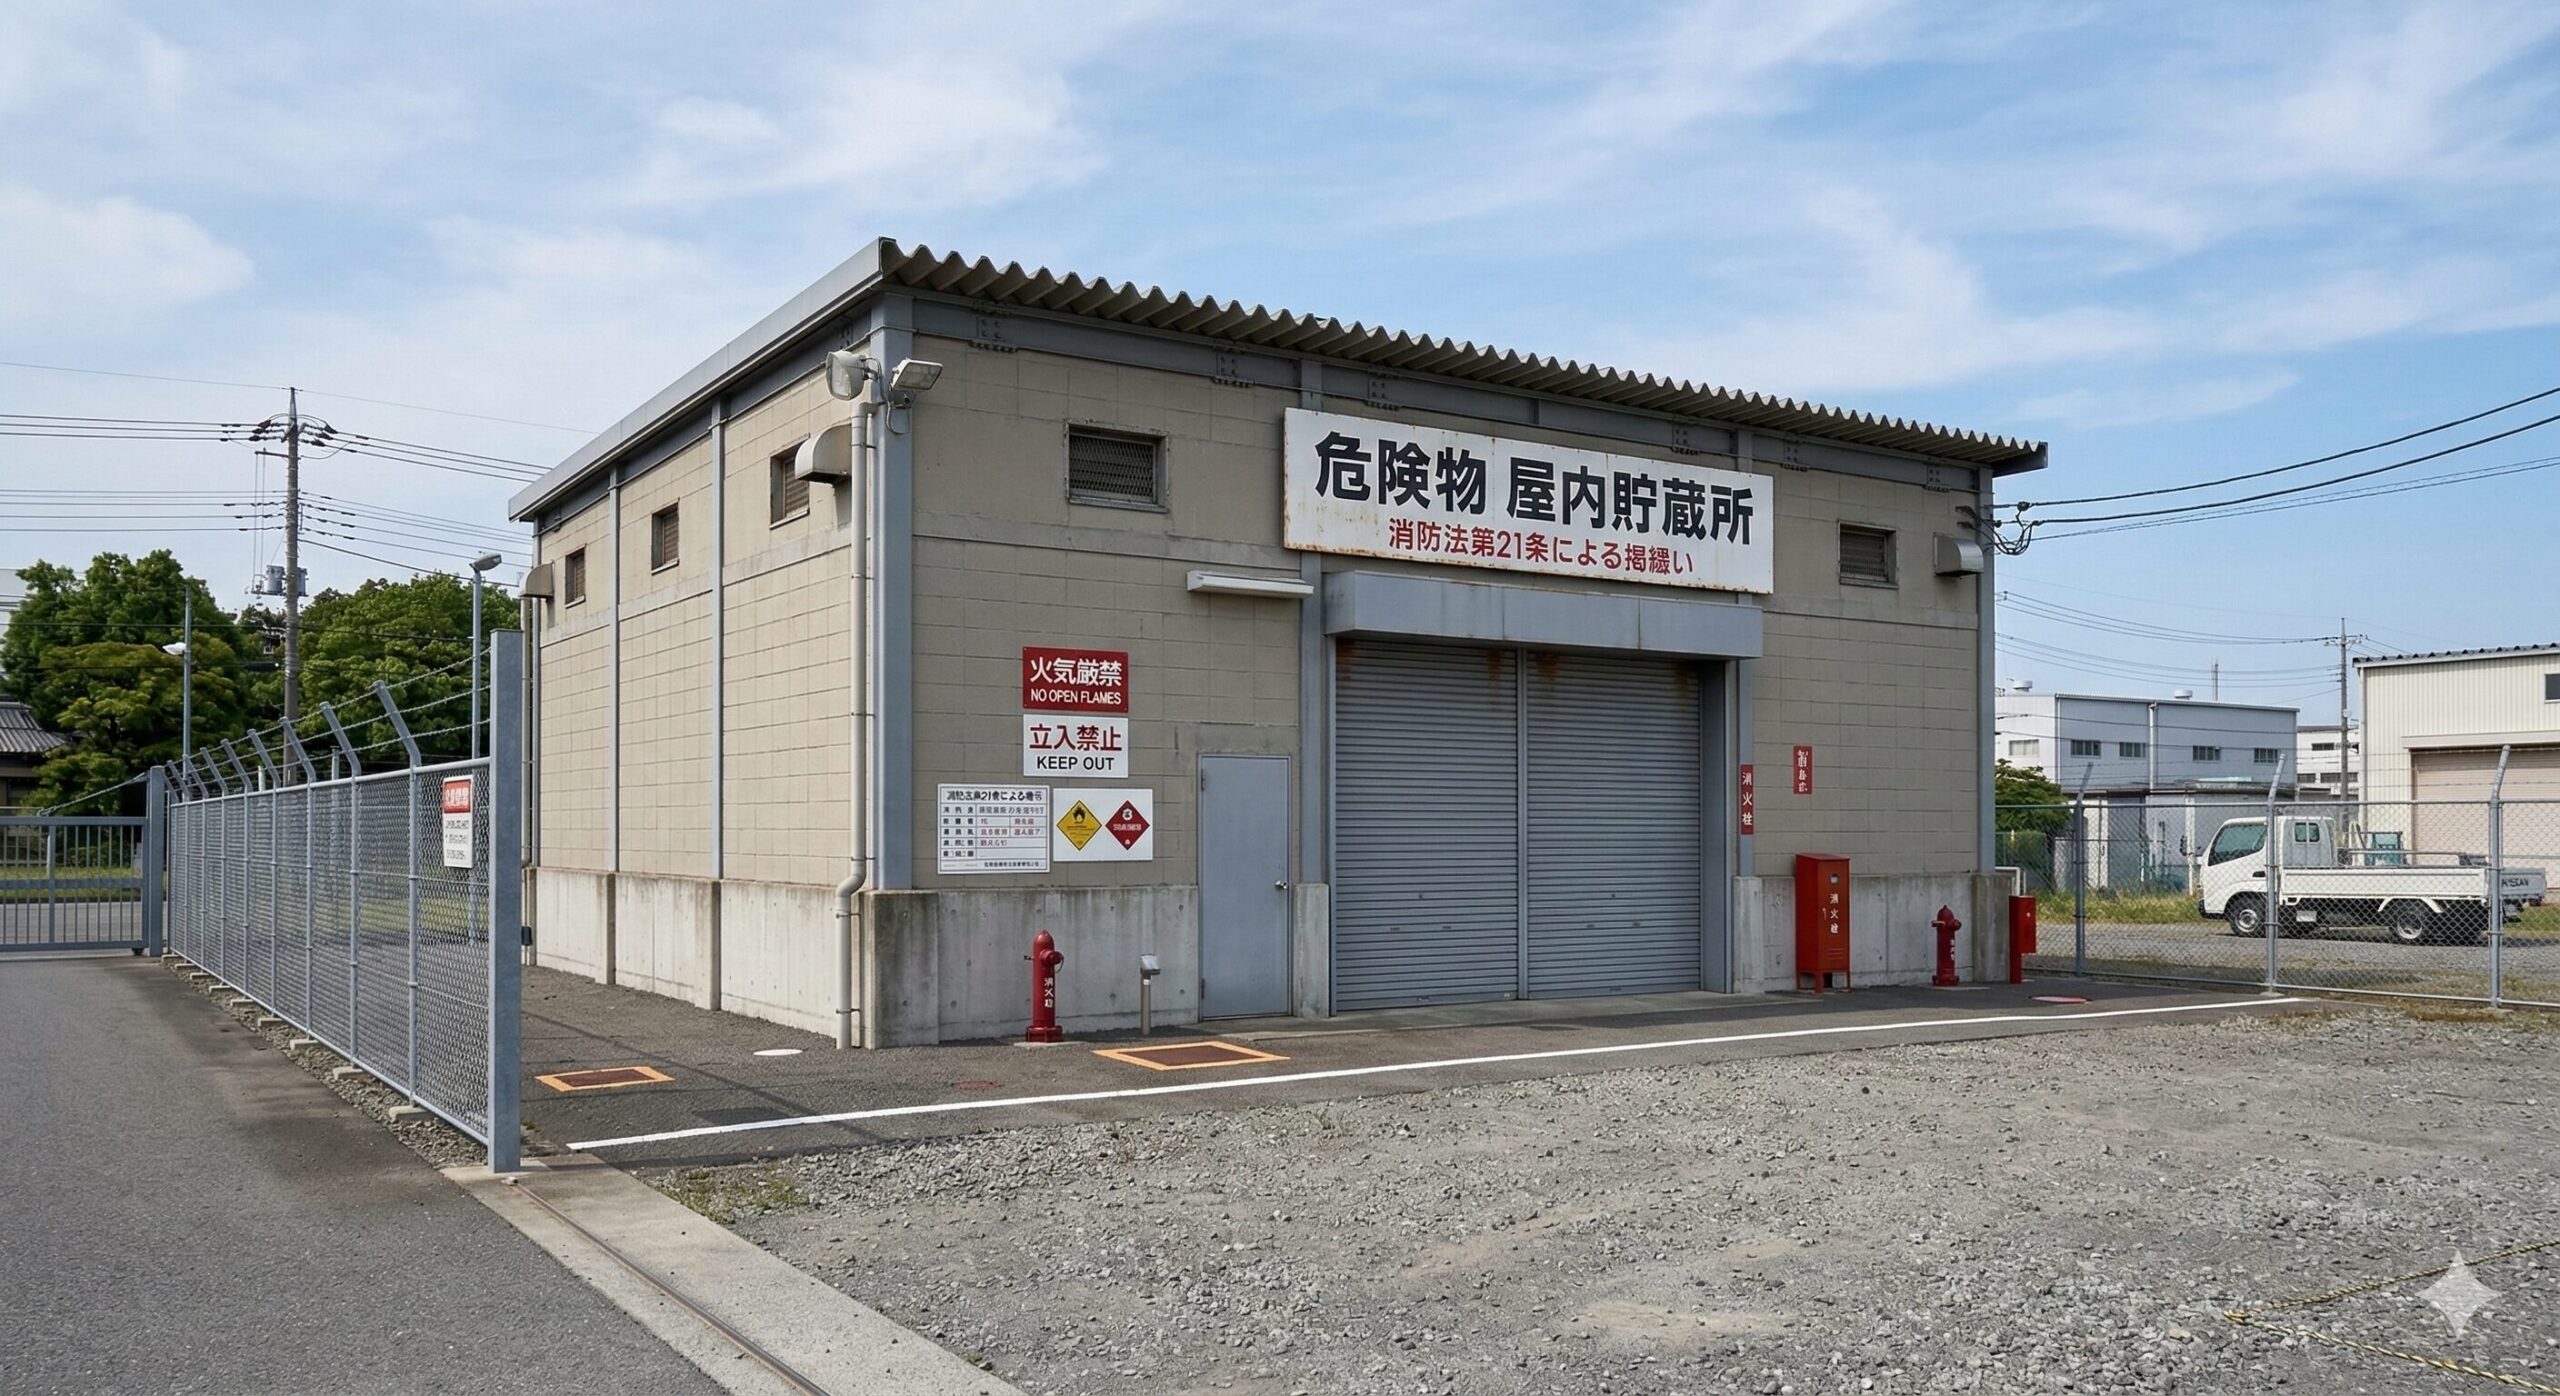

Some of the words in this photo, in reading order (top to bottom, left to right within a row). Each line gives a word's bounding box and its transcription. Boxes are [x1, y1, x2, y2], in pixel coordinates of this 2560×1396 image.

[1315, 431, 1486, 515] 危険物
[1506, 456, 1753, 545] 屋内貯蔵所
[1030, 656, 1122, 687] 火気厳禁
[1031, 688, 1047, 702] NO
[1048, 690, 1078, 704] OPEN
[1080, 691, 1121, 705] FLAMES
[1029, 723, 1122, 751] 立入禁止
[1036, 756, 1078, 770] KEEP
[1083, 757, 1115, 771] OUT
[1742, 771, 1753, 826] 消火栓
